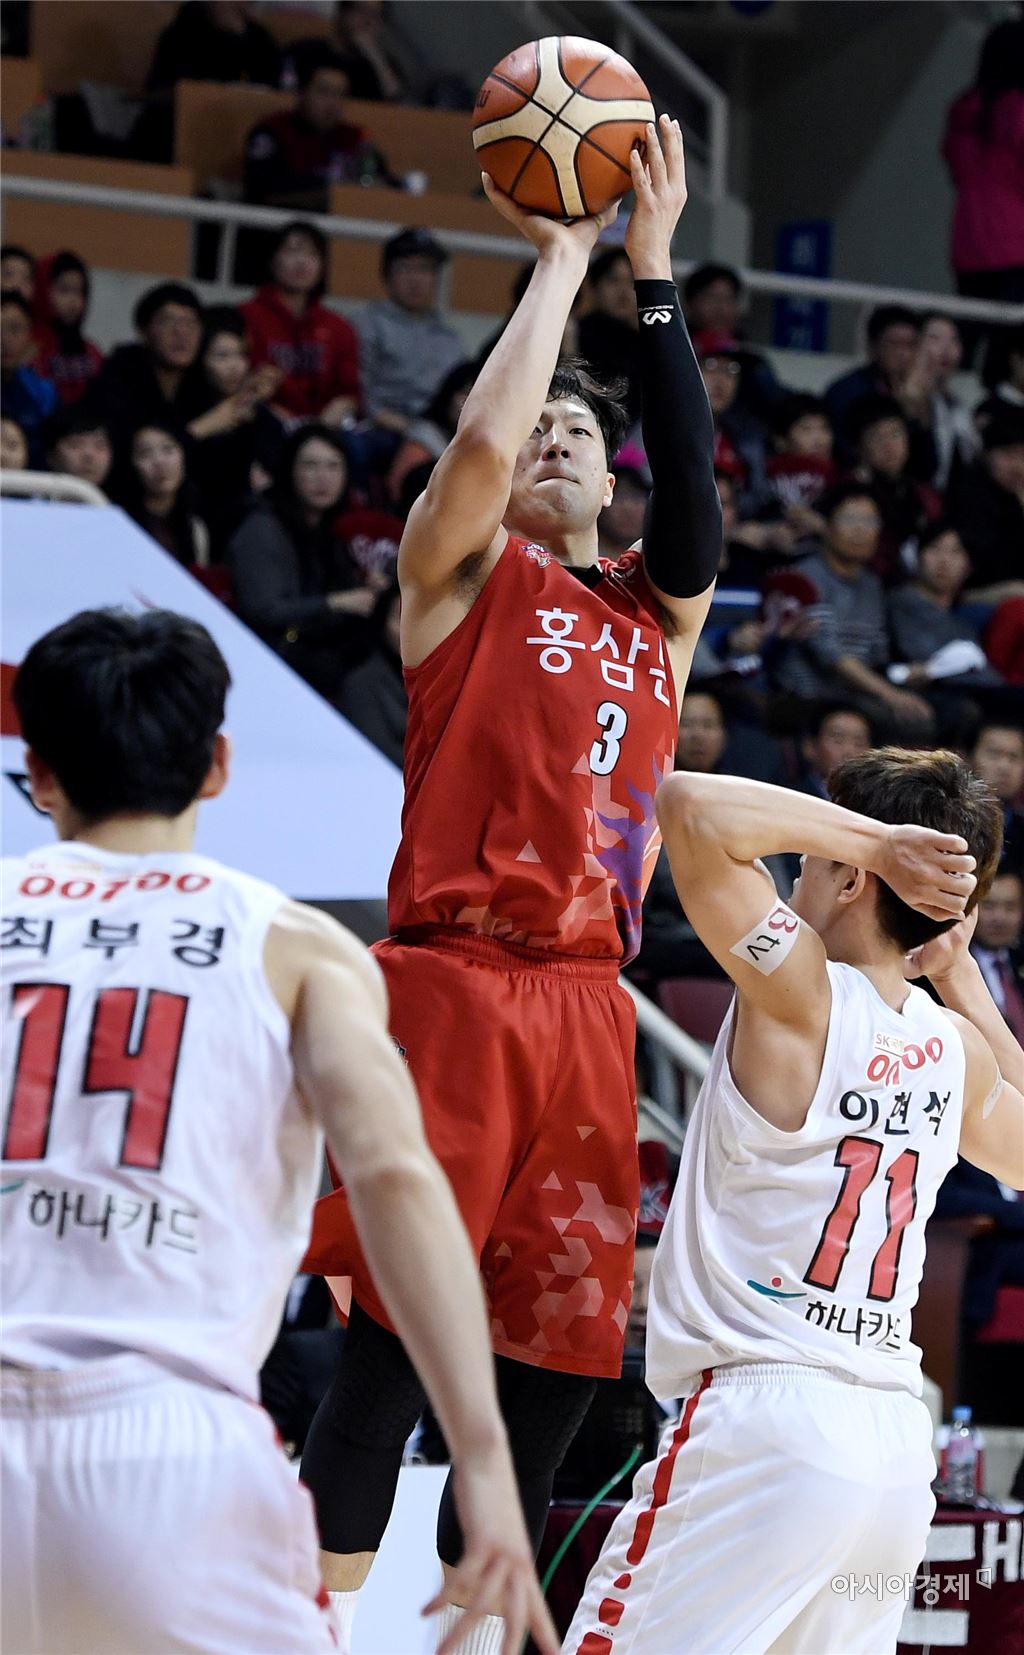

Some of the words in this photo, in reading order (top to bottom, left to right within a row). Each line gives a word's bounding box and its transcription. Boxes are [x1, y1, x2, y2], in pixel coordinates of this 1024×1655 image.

[589, 700, 629, 777] 3
[746, 934, 782, 962] tv
[767, 907, 799, 934] B
[2, 982, 191, 1172] 14
[839, 1090, 952, 1136] 이현석
[27, 1189, 200, 1255] 하나카드
[802, 1135, 919, 1303] 11
